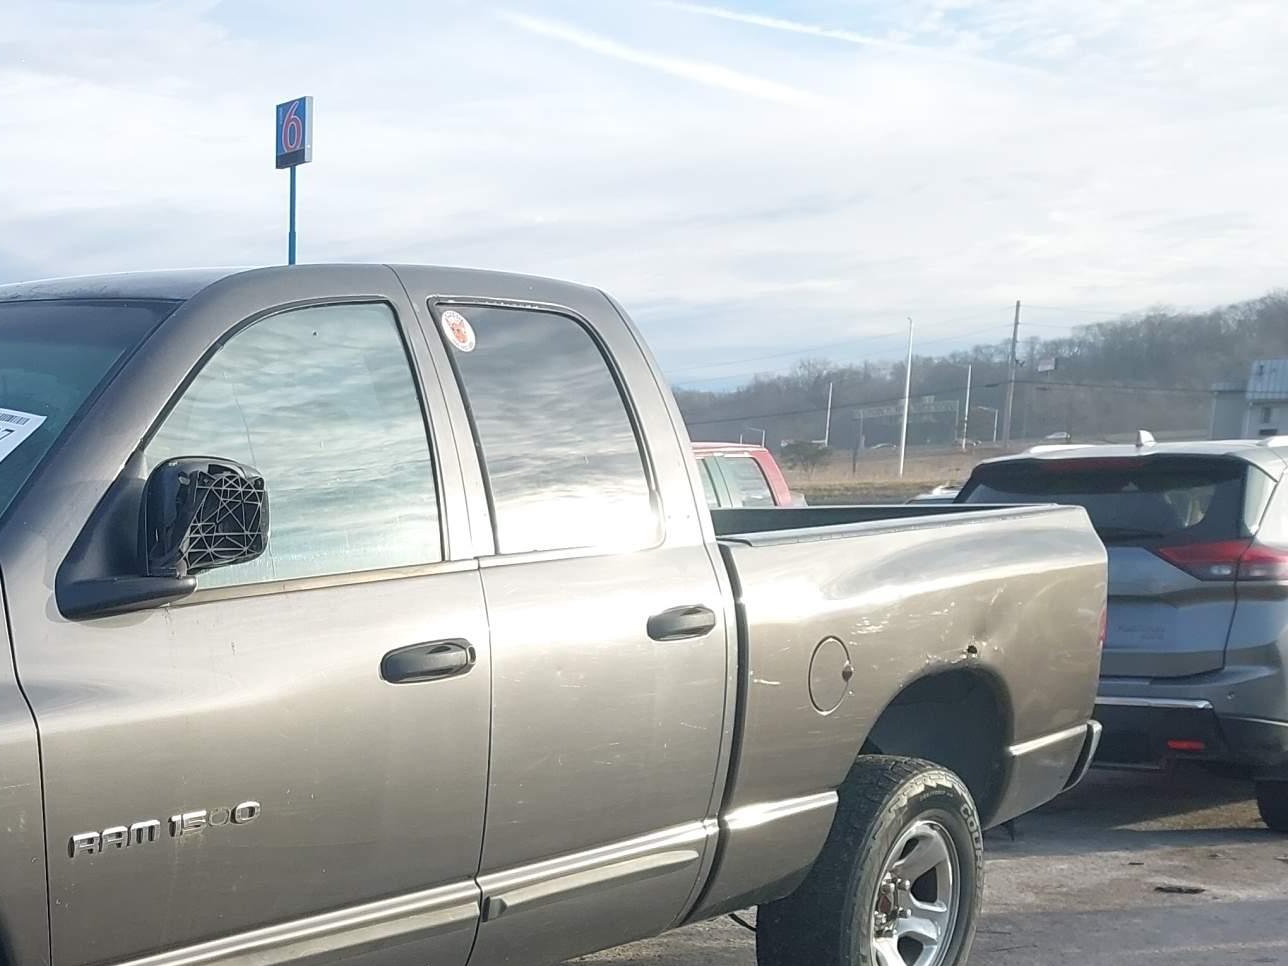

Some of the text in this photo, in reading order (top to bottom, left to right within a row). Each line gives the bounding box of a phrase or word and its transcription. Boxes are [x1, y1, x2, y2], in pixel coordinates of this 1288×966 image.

[282, 100, 302, 153] 6
[67, 800, 261, 858] RAM 1500
